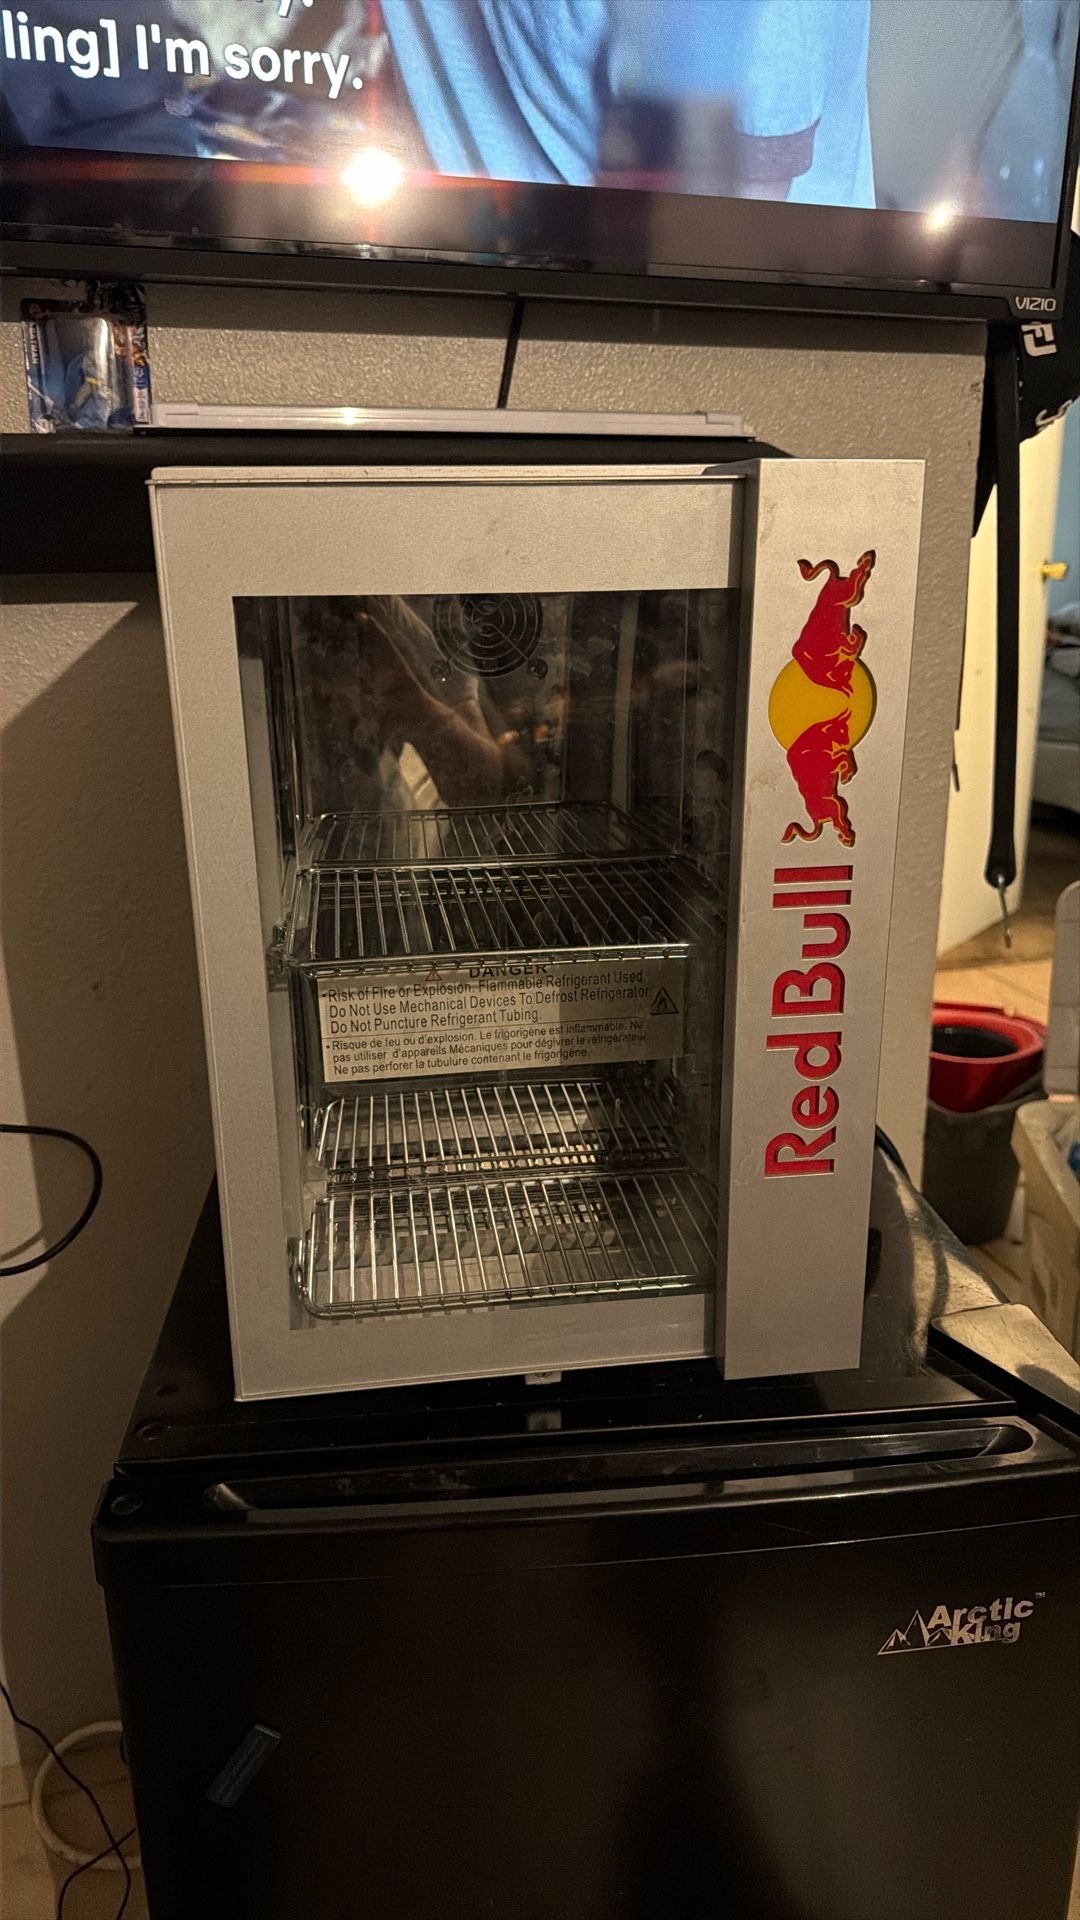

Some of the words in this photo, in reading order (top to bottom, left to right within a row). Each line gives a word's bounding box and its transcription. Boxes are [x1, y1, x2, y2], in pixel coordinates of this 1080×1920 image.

[2, 9, 121, 79] ling]
[136, 23, 210, 76] I'm
[224, 42, 364, 100] sorry.
[1015, 296, 1057, 312] VIZIO
[771, 865, 854, 1019] Bull
[328, 988, 355, 1002] Risk
[357, 987, 370, 1000] of
[372, 986, 396, 999] Fire
[398, 987, 411, 998] or
[413, 982, 476, 998] Explosion.
[481, 977, 543, 992] Flammable
[546, 971, 611, 989] Refrigerant
[614, 969, 647, 984] Used.
[469, 964, 548, 979] DANGER
[329, 1005, 346, 1018] Do
[349, 1004, 370, 1017] Not
[373, 1002, 397, 1015] Use
[399, 996, 467, 1013] Mechanical
[470, 994, 516, 1009] Devices
[519, 992, 533, 1005] To
[535, 989, 578, 1004] Defrost
[581, 985, 648, 1002] Refrigerator
[330, 1021, 347, 1034] Do
[350, 1020, 371, 1032] Not
[374, 1017, 427, 1031] Puncture
[430, 1012, 497, 1028] Refrigerant
[499, 1008, 542, 1023] Tubing.
[332, 1040, 367, 1050] Risque
[369, 1038, 382, 1048] de
[385, 1036, 401, 1047] feu
[403, 1037, 416, 1045] ou
[418, 1033, 477, 1047] d'explosion.
[480, 1030, 492, 1040] Le
[549, 1025, 564, 1035] est
[333, 1054, 351, 1064] pas
[354, 1050, 387, 1061] utiliser
[392, 1046, 447, 1060] d'appareils
[449, 1043, 508, 1054] Mécaniques
[510, 1040, 533, 1051] pour
[535, 1037, 574, 1050] dégivrer
[576, 1035, 585, 1045] le
[334, 1065, 348, 1075] Ne
[351, 1065, 370, 1075] pas
[373, 1061, 413, 1073] perforer
[415, 1059, 425, 1069] la
[427, 1057, 469, 1068] tubulure
[471, 1053, 521, 1065] contenant
[522, 1051, 532, 1061] le
[764, 1031, 842, 1179] Red
